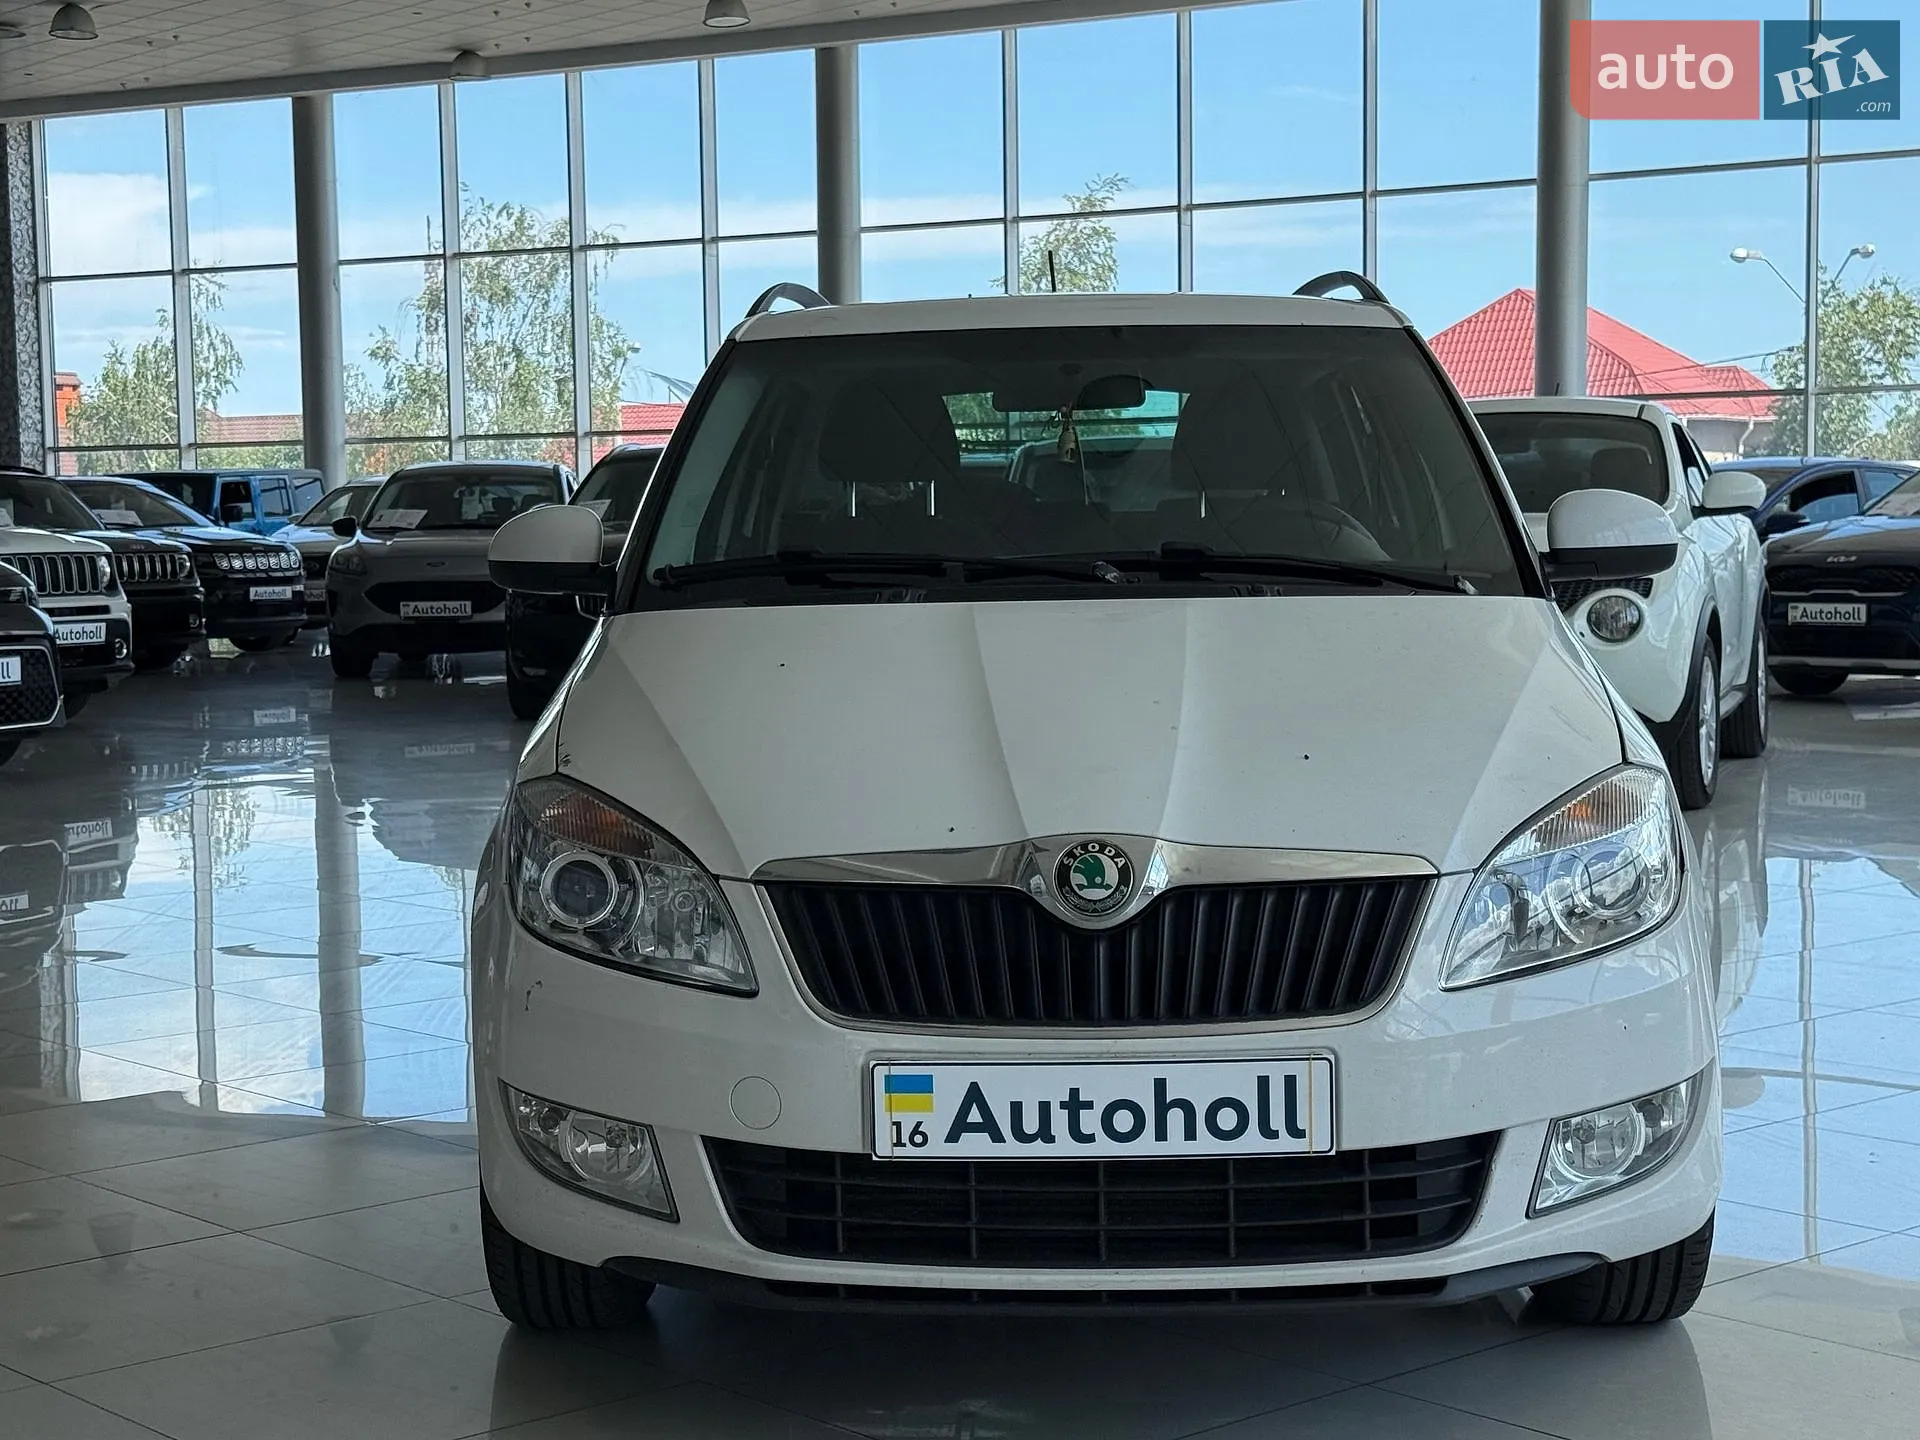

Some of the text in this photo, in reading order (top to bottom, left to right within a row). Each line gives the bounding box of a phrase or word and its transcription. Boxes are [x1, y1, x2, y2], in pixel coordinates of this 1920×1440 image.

[254, 588, 287, 598] Autoholl
[411, 603, 468, 616] Autoholl
[1800, 606, 1862, 621] Autoholl
[54, 626, 103, 641] Autoholl
[891, 1074, 1307, 1149] 16 Autoholl
